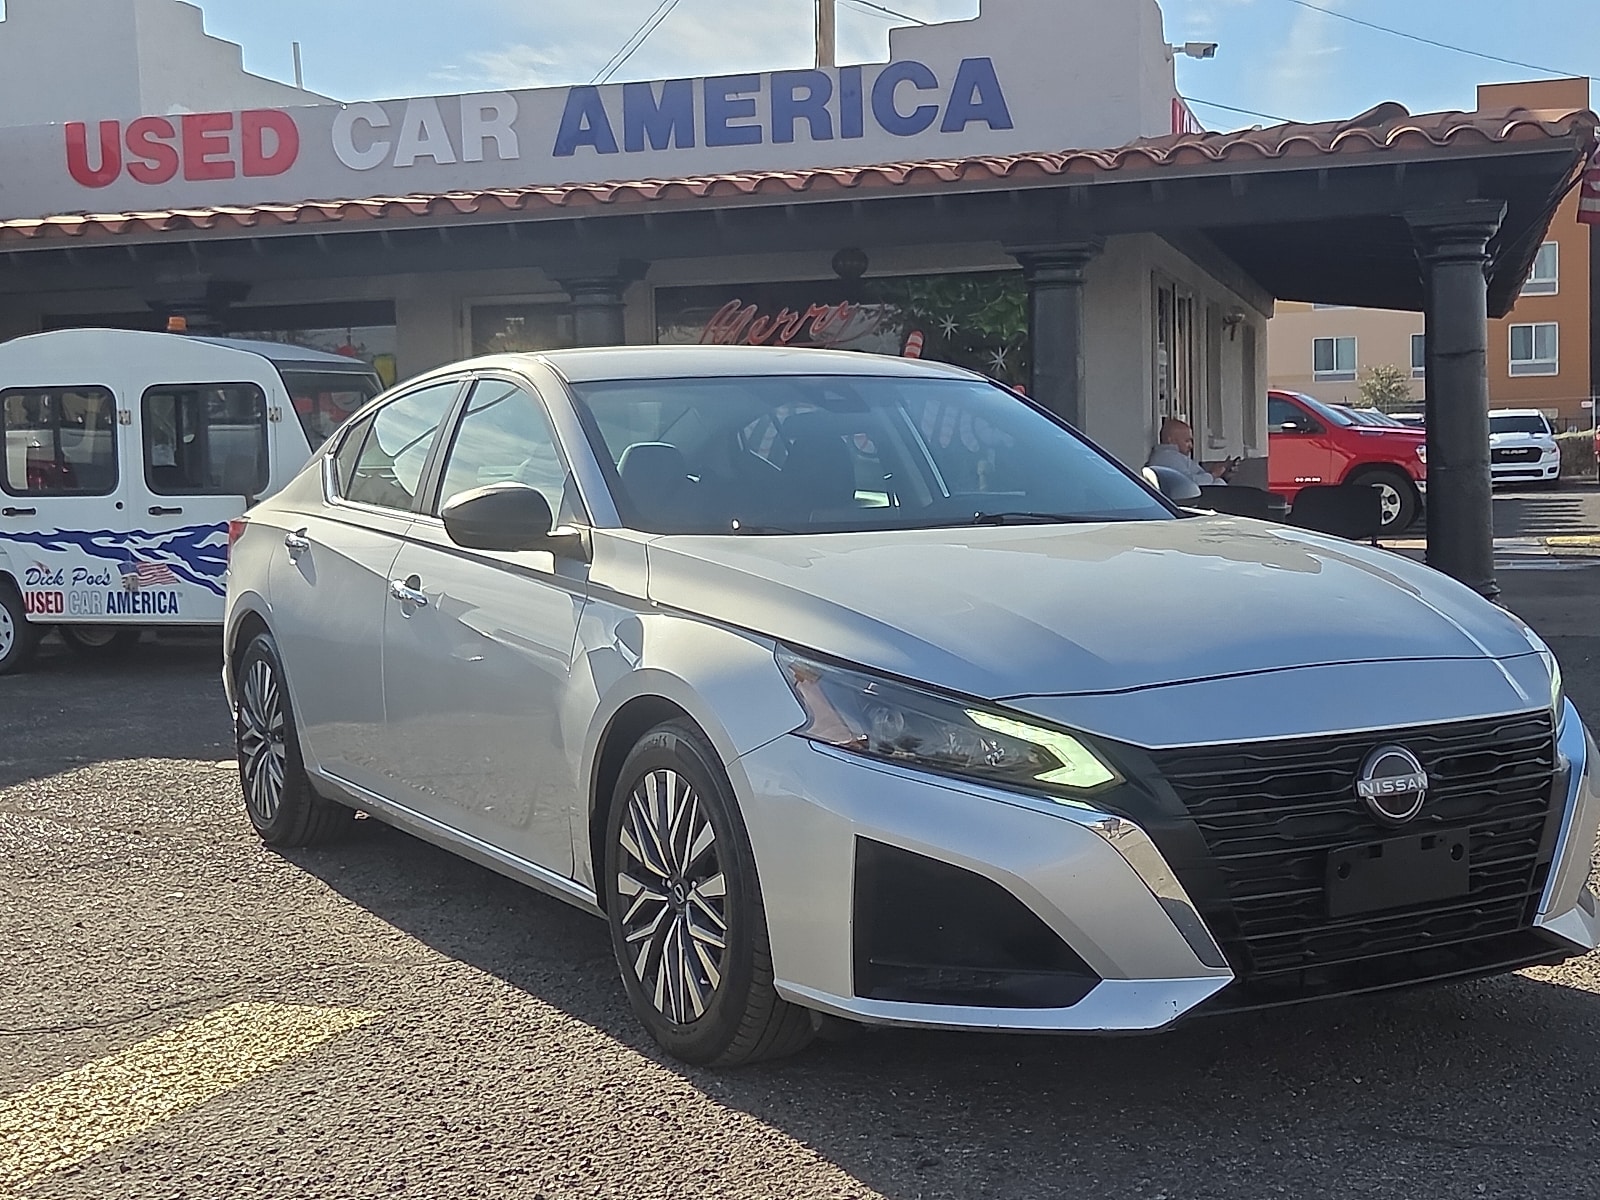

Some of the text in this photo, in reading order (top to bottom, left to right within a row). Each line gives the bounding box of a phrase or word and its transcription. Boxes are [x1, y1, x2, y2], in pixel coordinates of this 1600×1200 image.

[64, 56, 1014, 189] USED CAR AMERICA
[700, 298, 866, 346] Merry
[25, 567, 113, 588] Dick Poe's
[25, 590, 179, 615] USED CAR AMERICA
[1359, 774, 1428, 795] NISSAN
